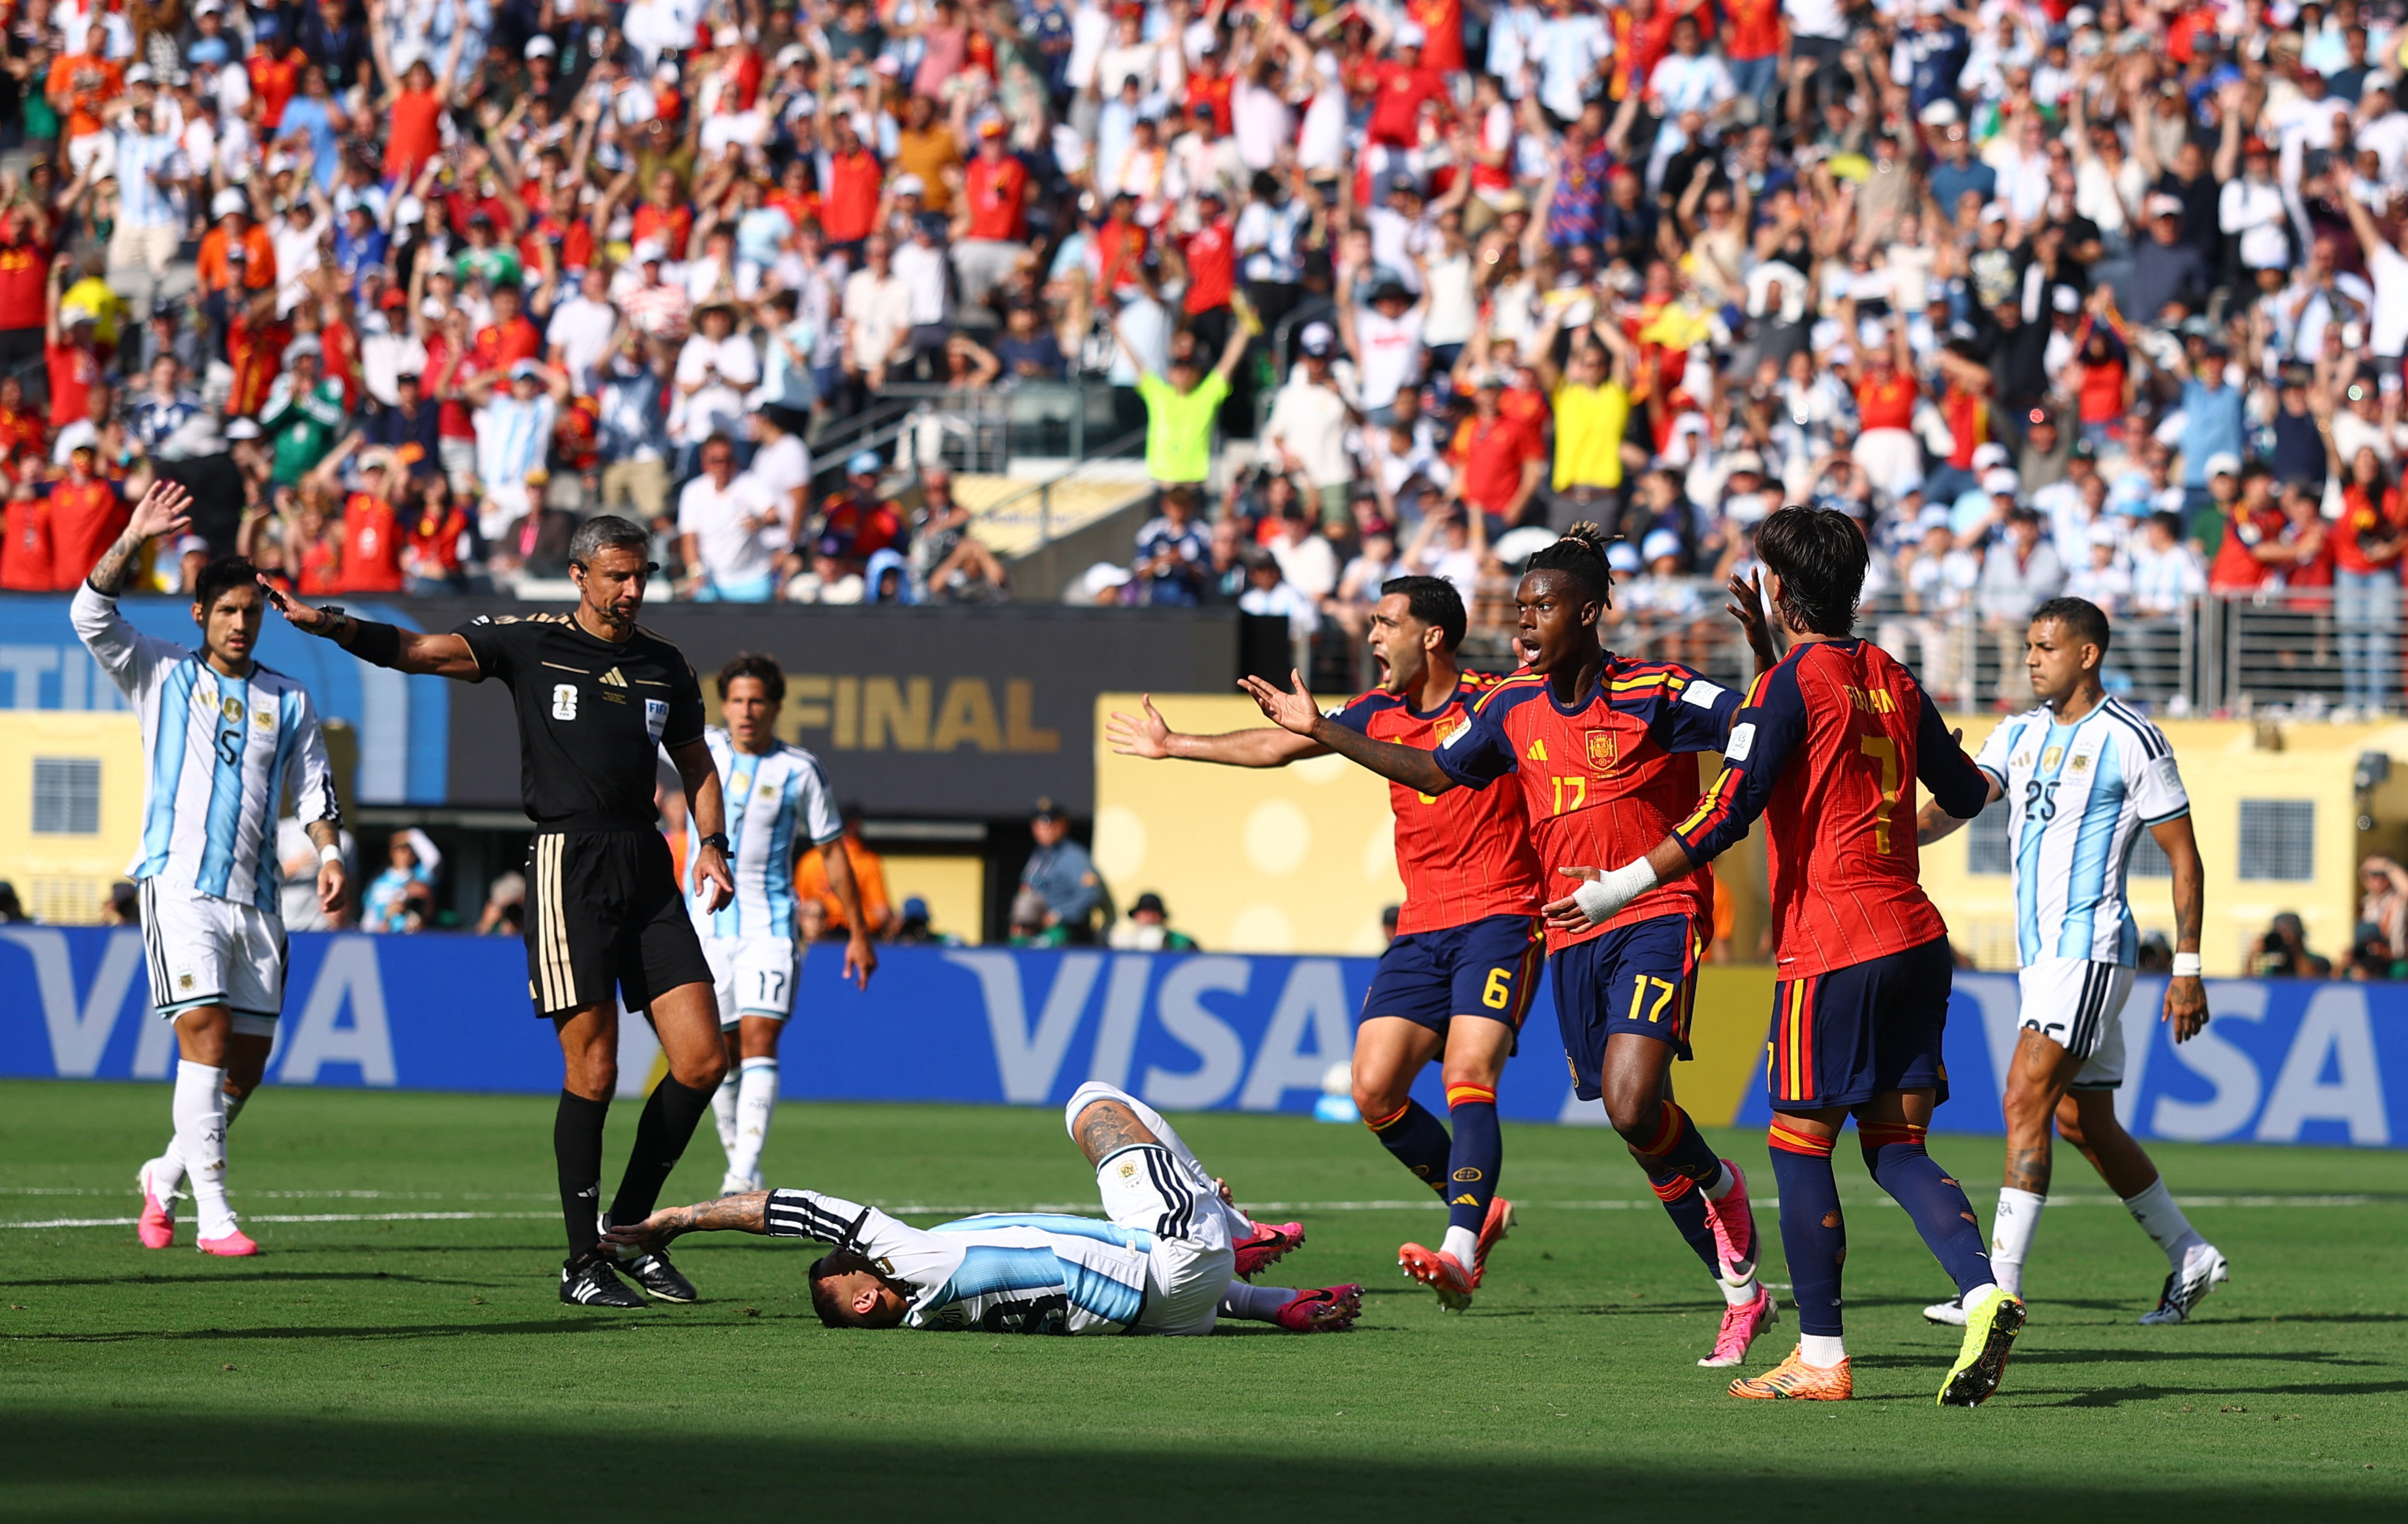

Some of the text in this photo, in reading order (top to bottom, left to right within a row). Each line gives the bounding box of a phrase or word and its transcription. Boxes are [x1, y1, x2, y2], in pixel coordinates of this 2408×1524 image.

[778, 674, 1060, 752] FINAL
[219, 730, 241, 765] 5
[1551, 776, 1585, 815] 17
[1861, 734, 1897, 854] 7
[2026, 780, 2061, 821] 25
[759, 970, 785, 1001] 17
[1482, 967, 1512, 1010] 6
[1628, 974, 1674, 1023] 17
[941, 950, 1354, 1111] VISA
